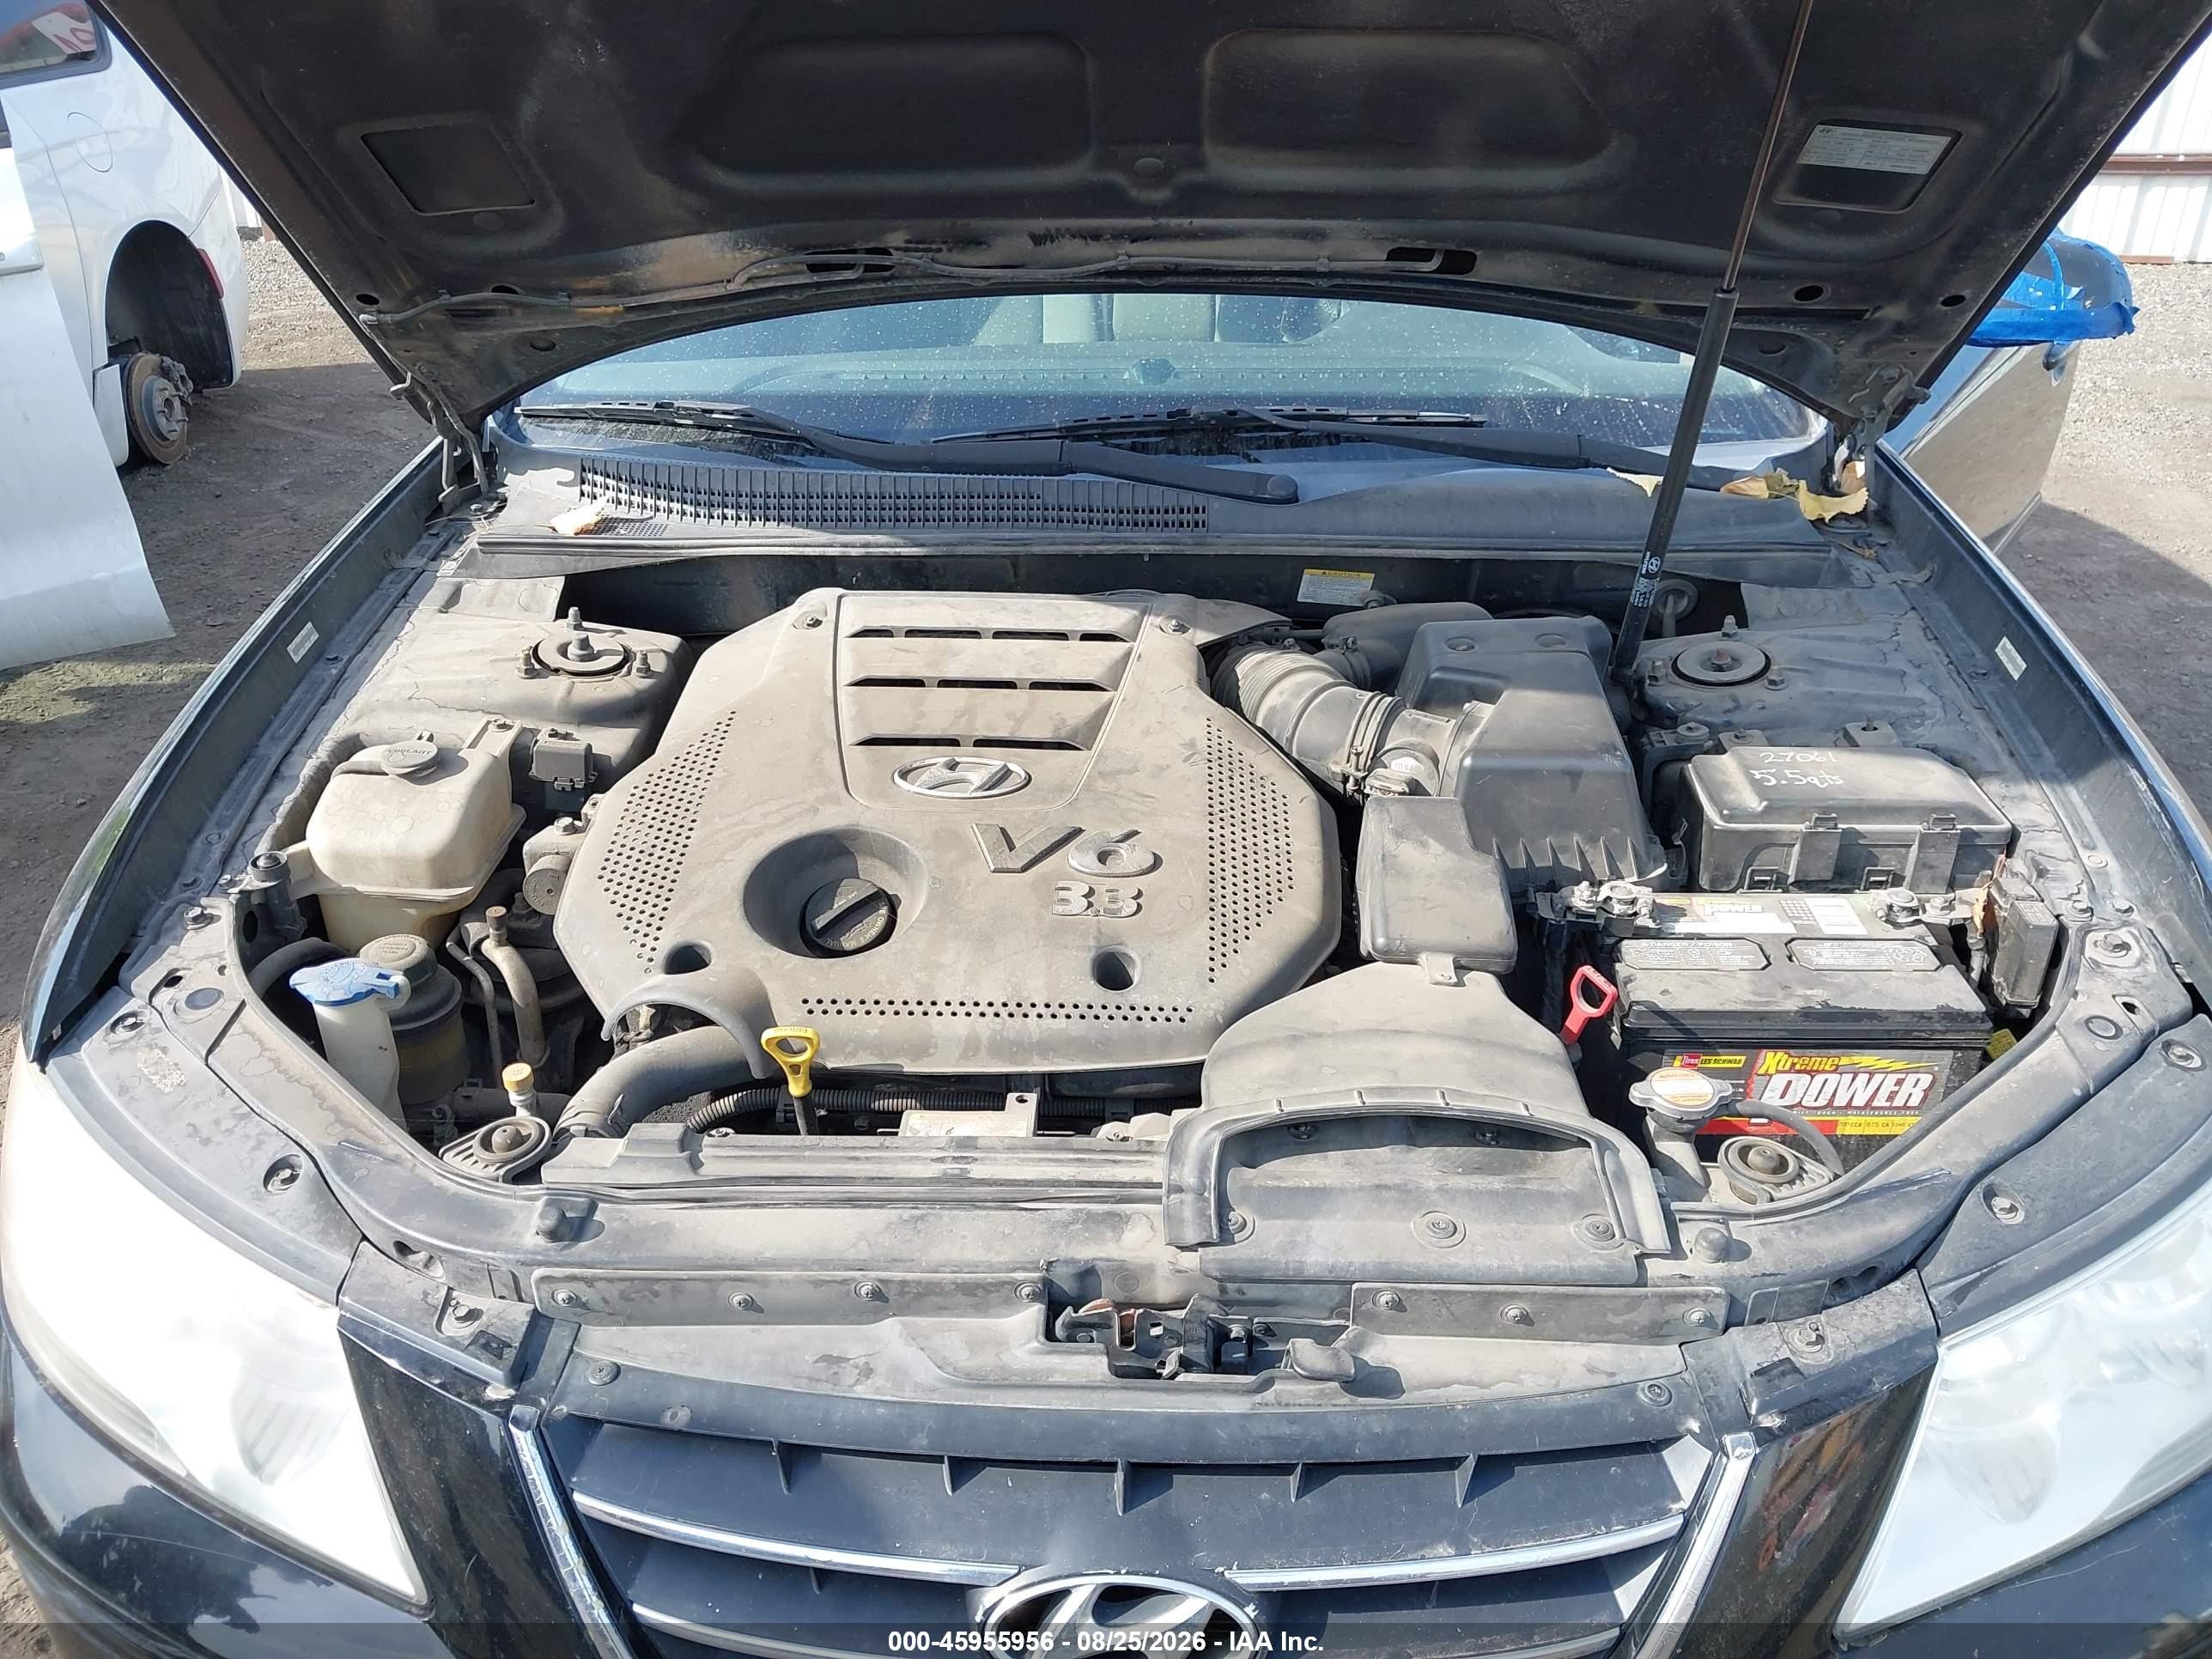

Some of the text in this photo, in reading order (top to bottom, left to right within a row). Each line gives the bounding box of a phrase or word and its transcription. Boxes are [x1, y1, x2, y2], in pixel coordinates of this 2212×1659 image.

[1759, 750, 1838, 764] 27061
[970, 823, 1160, 878] V6
[1683, 1055, 1699, 1065] Tires
[1758, 1050, 1840, 1075] Xtreme
[1749, 1073, 1936, 1126] POWER
